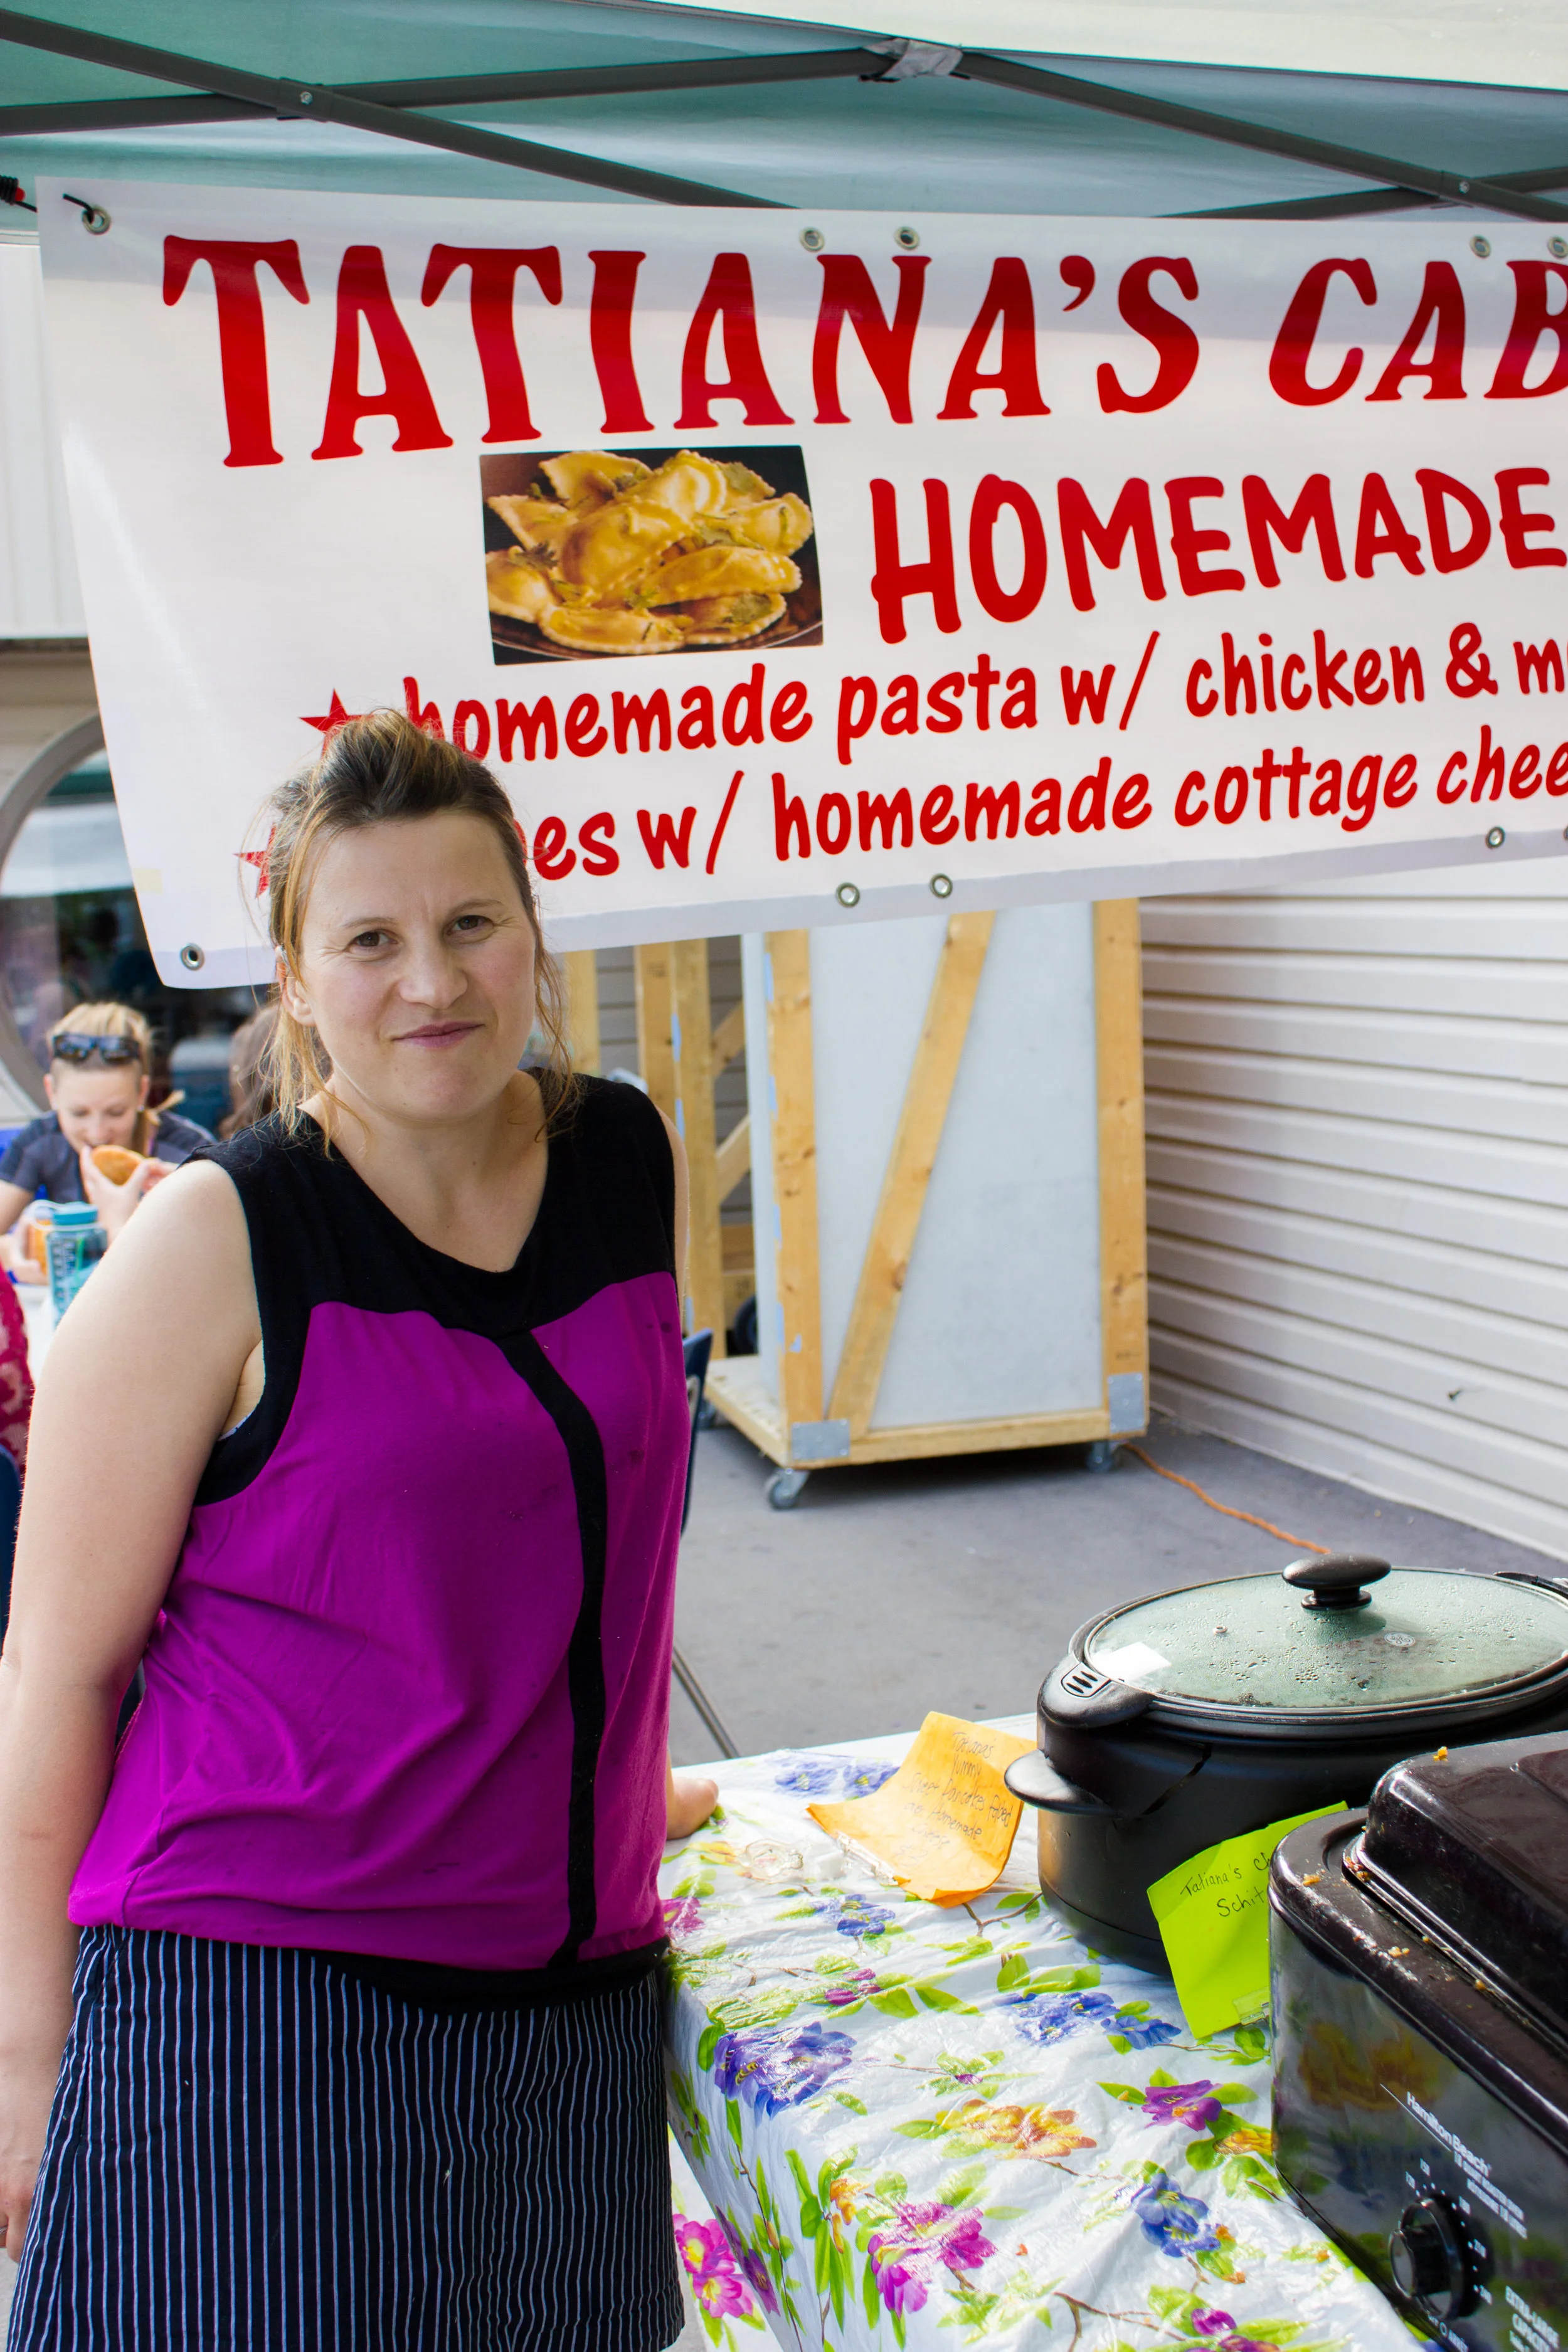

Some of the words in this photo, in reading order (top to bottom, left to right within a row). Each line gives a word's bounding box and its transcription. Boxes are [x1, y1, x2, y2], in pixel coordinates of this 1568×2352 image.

[162, 235, 1200, 469] TATIANA'S
[869, 467, 1567, 645] HOMEMADE
[403, 662, 813, 764] homemade
[836, 653, 1038, 766] pasta
[1059, 630, 1160, 731] w/
[1185, 629, 1425, 718] chicken
[1444, 622, 1499, 699] &
[1512, 637, 1568, 696] m
[512, 812, 620, 881] es
[636, 770, 745, 876] w/
[771, 756, 1153, 862] homemade
[1173, 746, 1418, 833] cottage
[928, 1802, 982, 1840] Homemade
[951, 1754, 982, 1786] Yummy
[1180, 1864, 1242, 1897] Tatiana's
[1406, 2091, 1453, 2146] Hamilton
[1452, 2134, 1489, 2178] Beach
